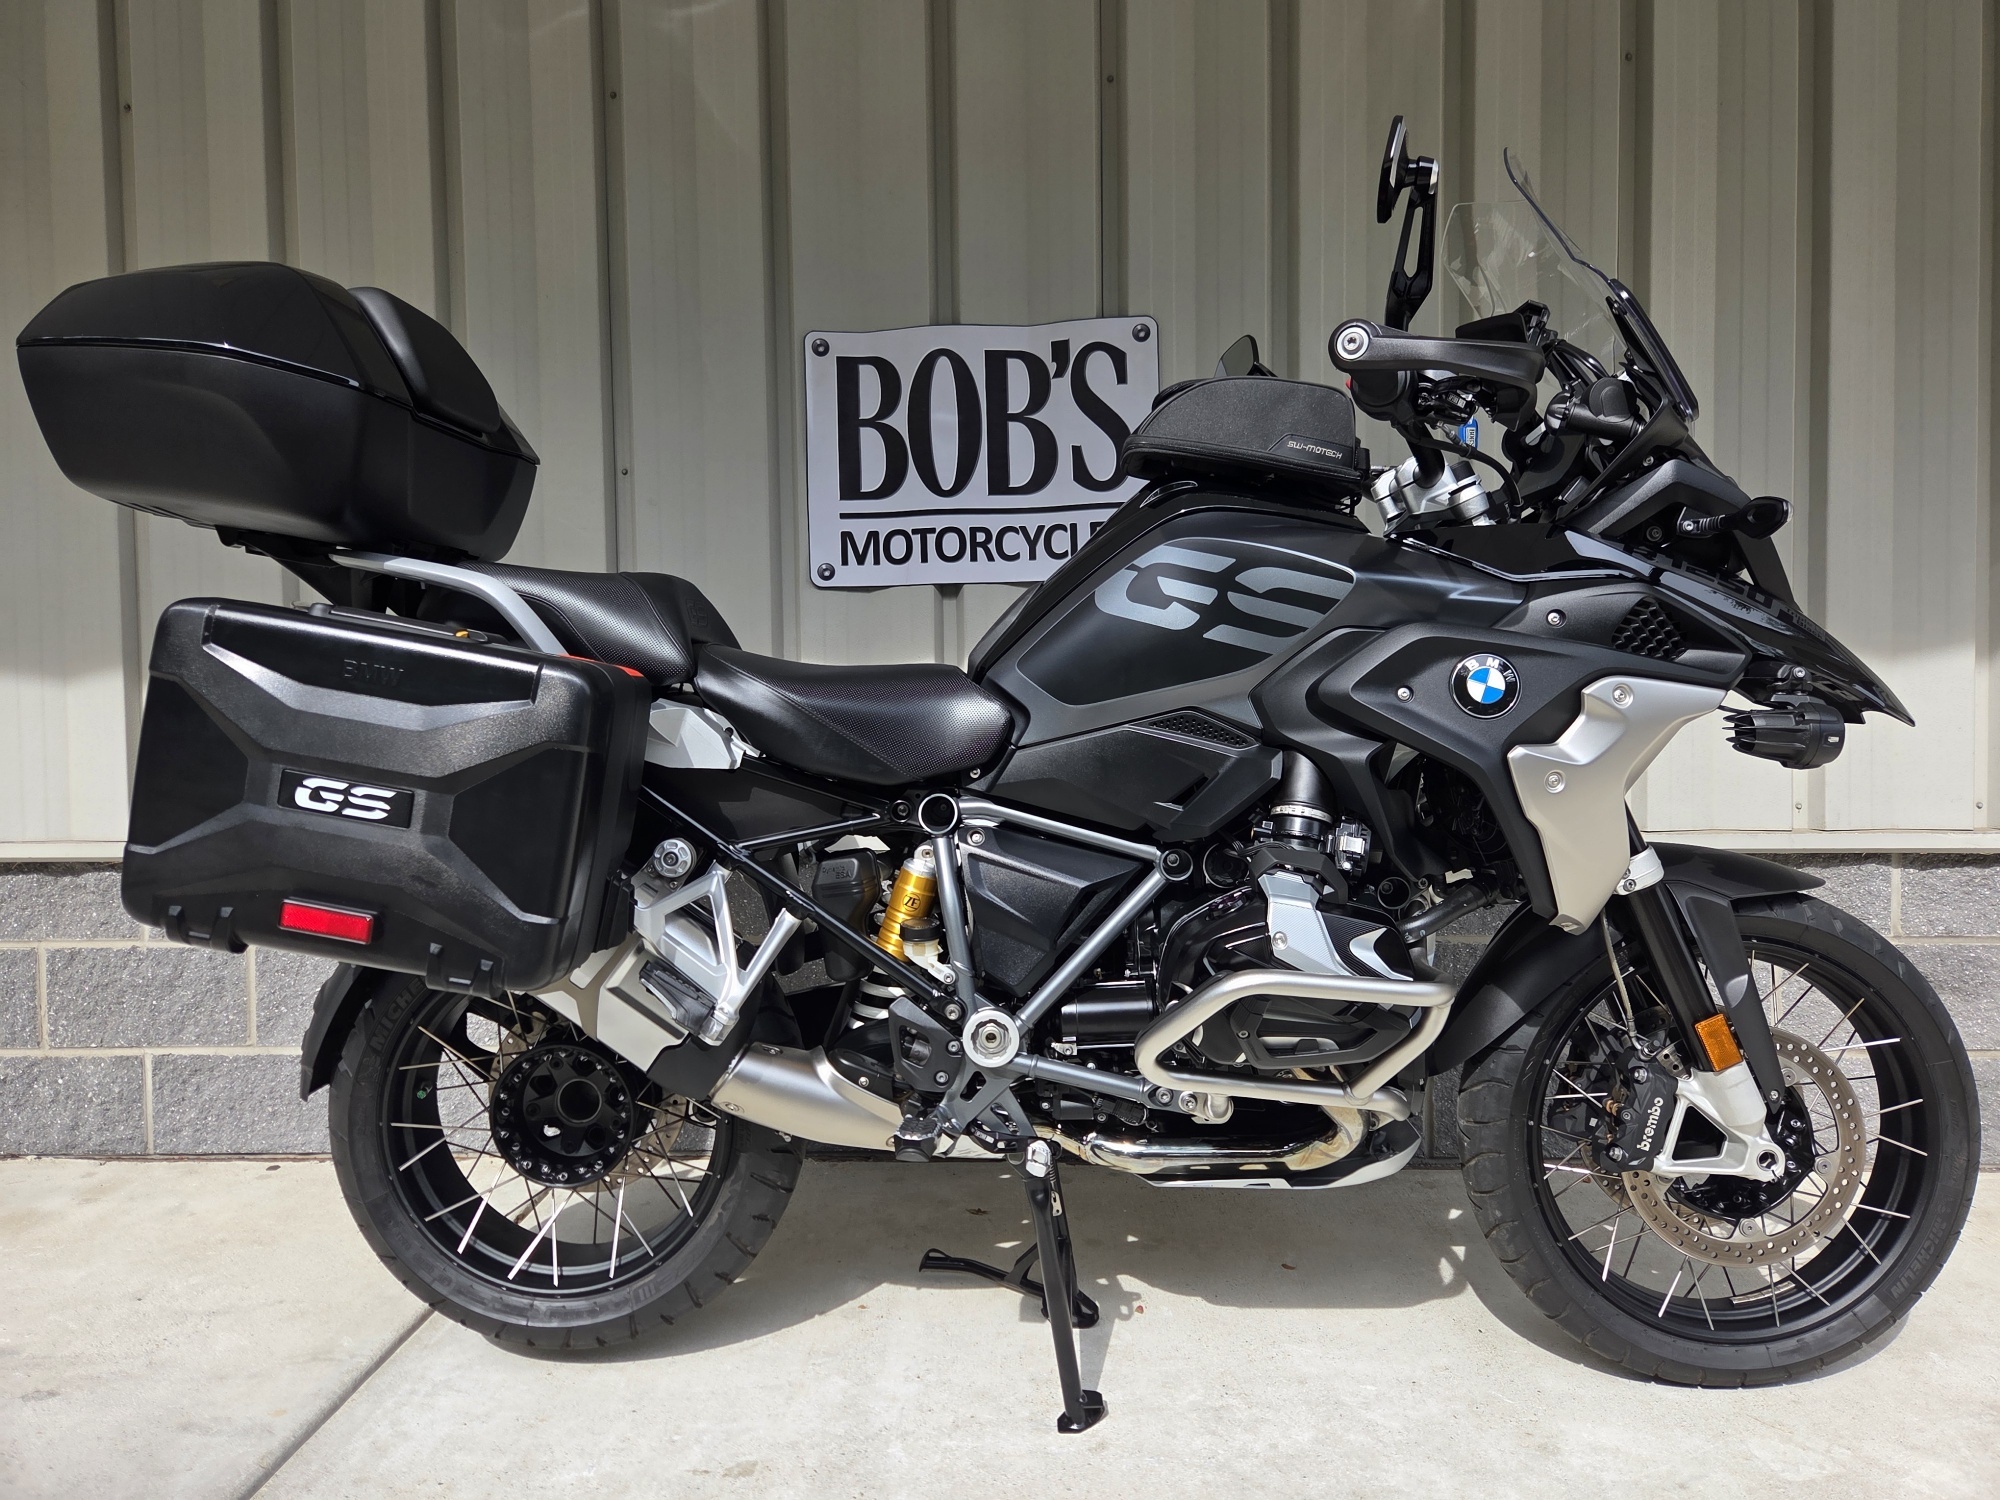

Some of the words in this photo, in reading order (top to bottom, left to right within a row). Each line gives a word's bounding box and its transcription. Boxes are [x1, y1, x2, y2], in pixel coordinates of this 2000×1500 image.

[835, 338, 1132, 501] BOB'S
[1286, 440, 1343, 460] SW-MOTECH
[840, 520, 1106, 567] MOTORCYCL
[1094, 545, 1354, 656] GS
[343, 659, 405, 687] BMW
[1464, 656, 1516, 683] BMW
[294, 777, 398, 820] GS
[1636, 1096, 1664, 1152] brembo
[1890, 1217, 1947, 1299] MICHELIN
